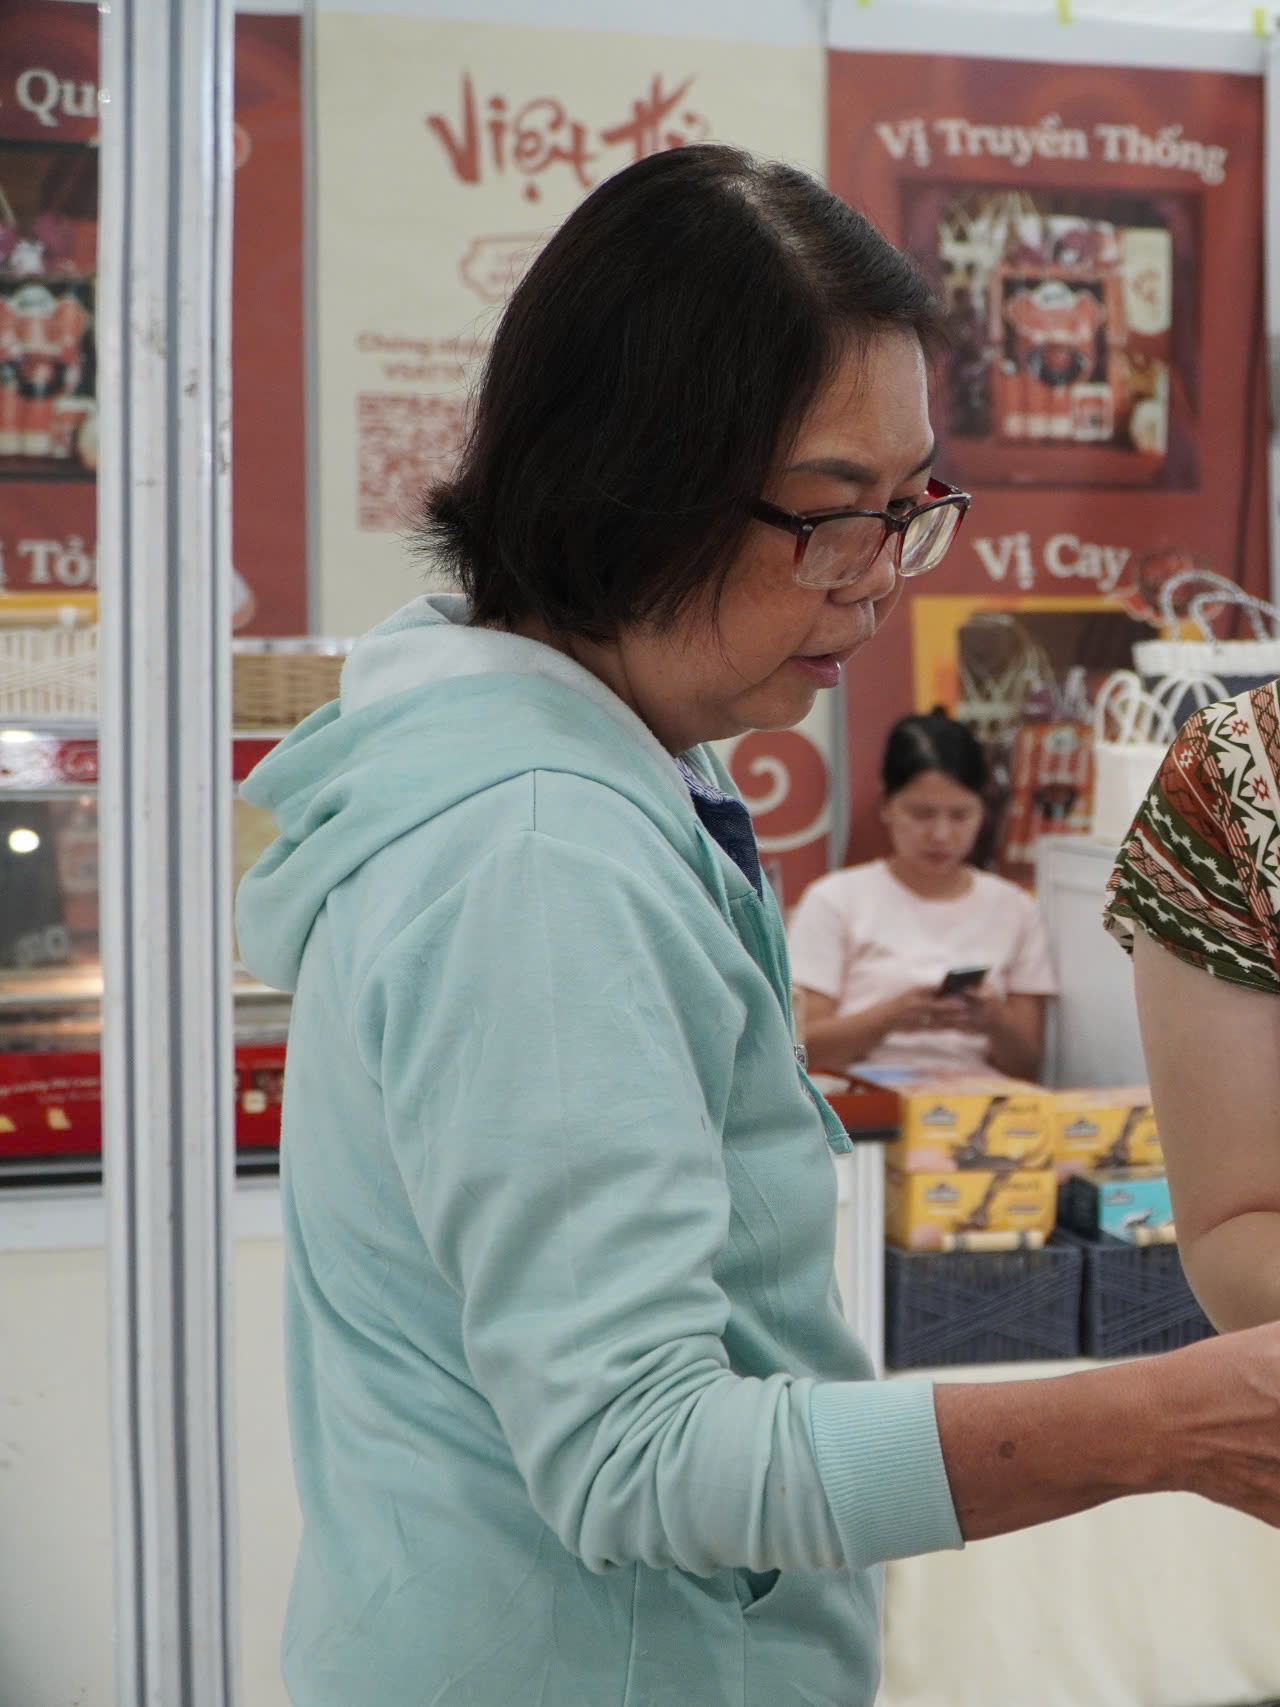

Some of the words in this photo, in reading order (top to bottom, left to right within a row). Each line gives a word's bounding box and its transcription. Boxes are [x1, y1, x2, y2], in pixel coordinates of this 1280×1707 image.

[16, 68, 97, 127] Qu
[876, 118, 931, 168] Vị
[933, 113, 1088, 167] Truyền
[1096, 123, 1228, 185] Thống
[18, 535, 97, 586] Tỏ
[974, 531, 1035, 590] Vị
[1043, 533, 1130, 592] Cay
